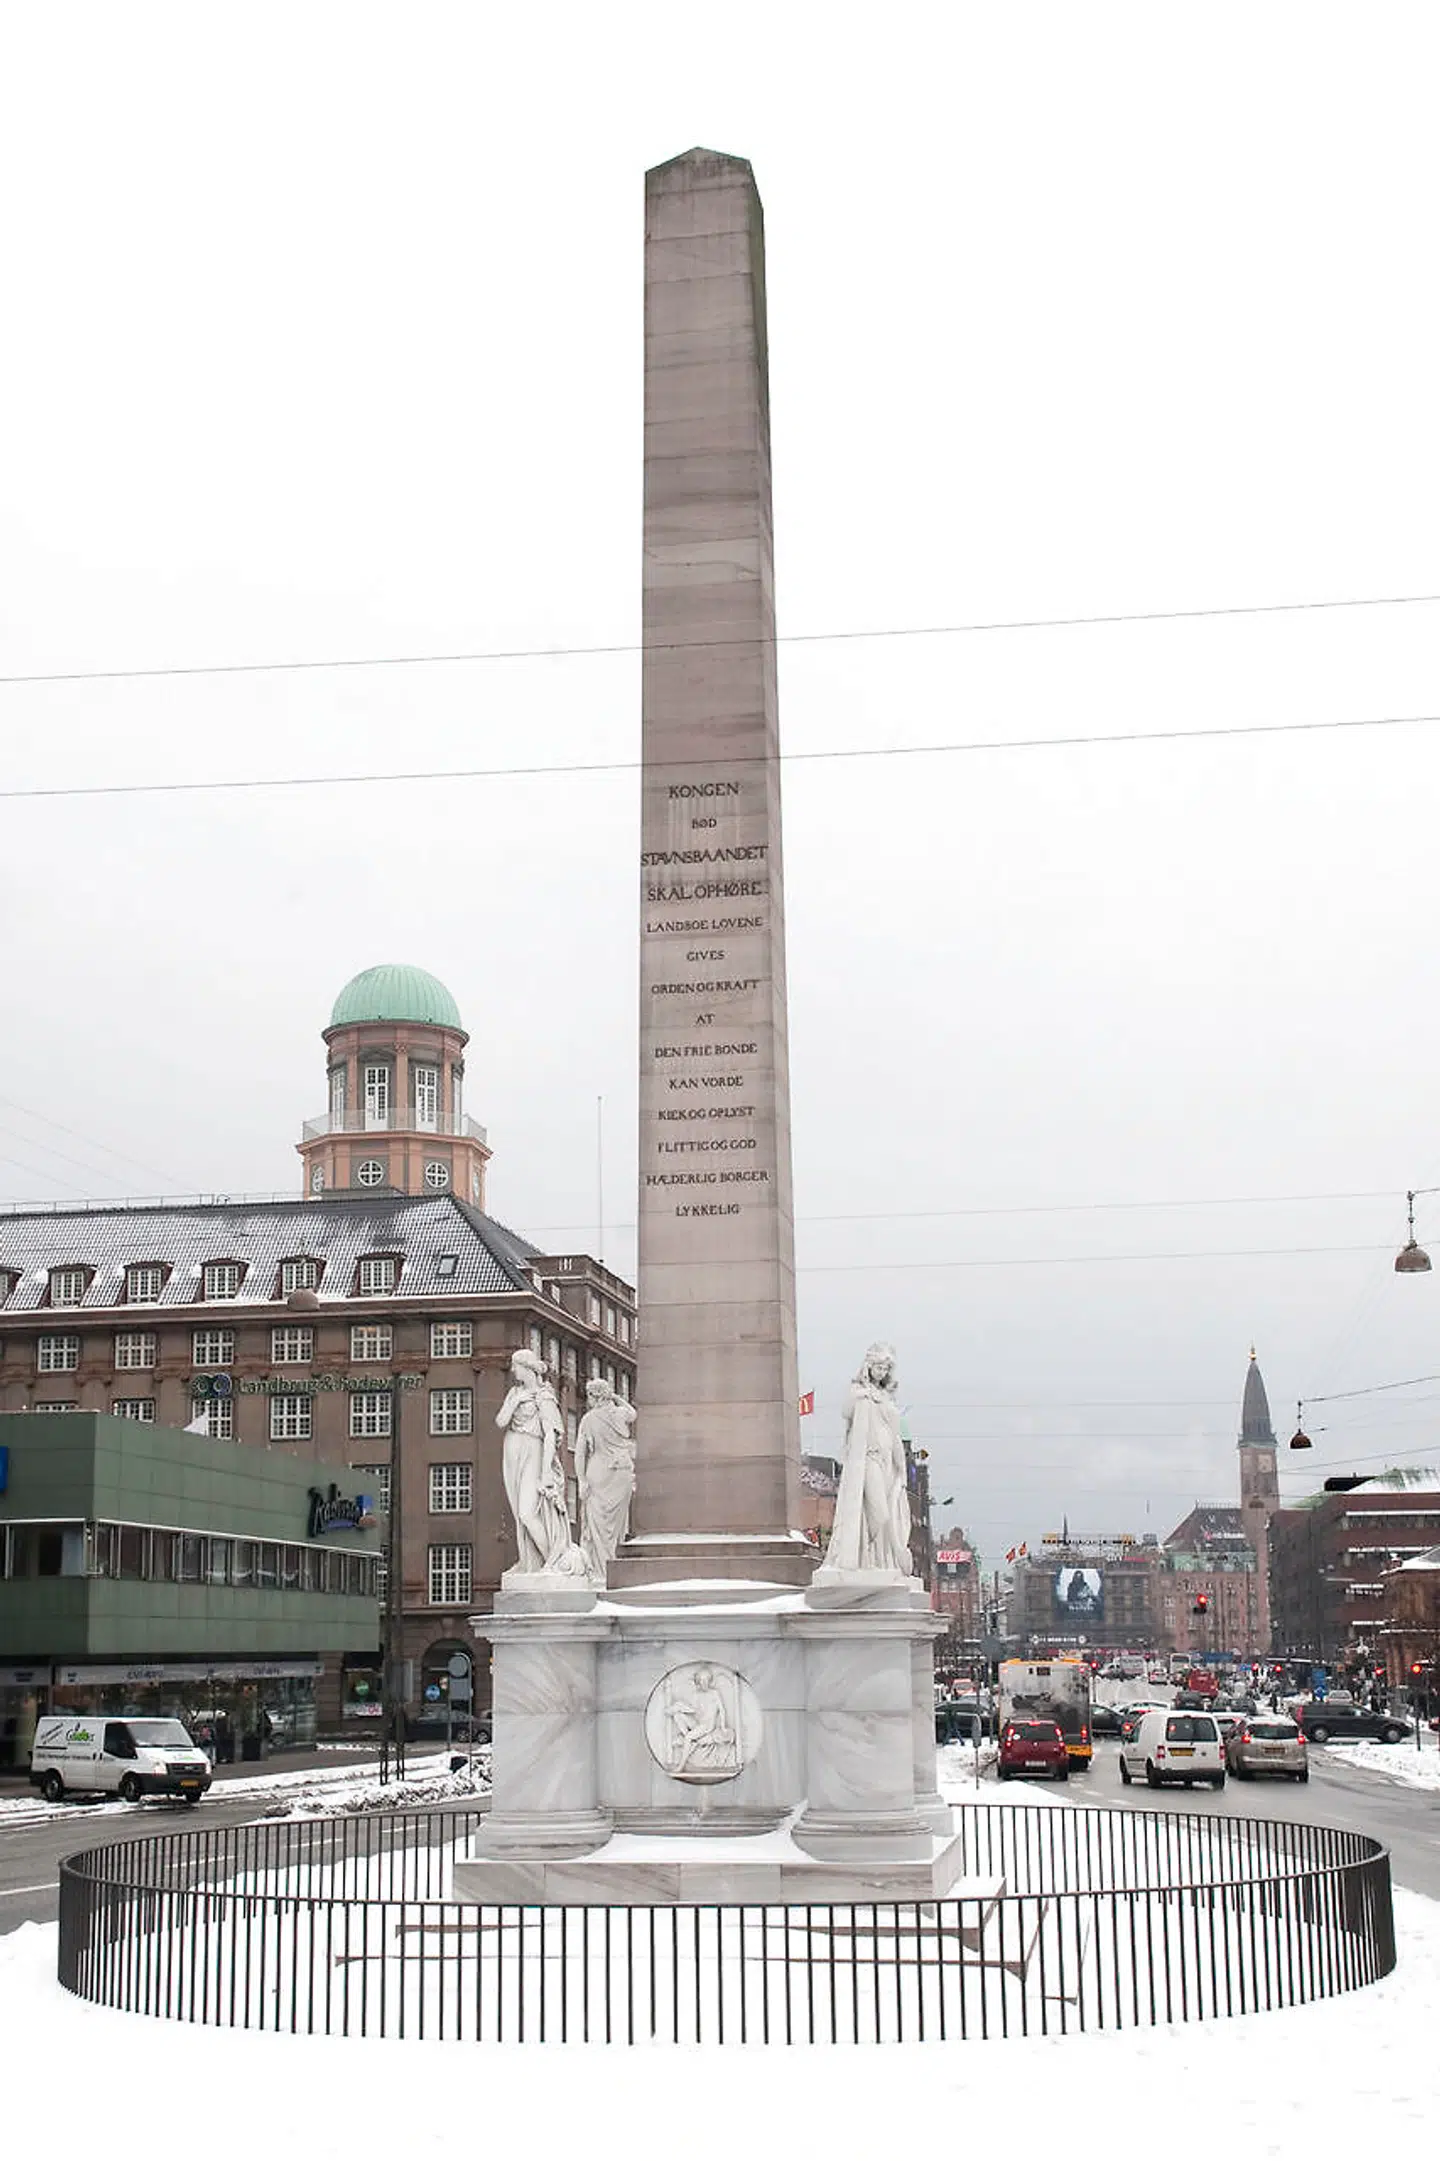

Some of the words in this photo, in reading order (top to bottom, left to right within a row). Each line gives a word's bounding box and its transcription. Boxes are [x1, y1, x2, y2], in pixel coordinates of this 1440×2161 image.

[669, 783, 740, 798] KONGEN
[641, 846, 769, 866] STAVNSBAANDET
[648, 886, 692, 901] SKAL
[647, 920, 708, 933] LANDBOE
[712, 917, 763, 930] LOVENE
[686, 950, 725, 961] GIVES
[651, 983, 694, 995] ORDEN
[696, 981, 714, 992] OG
[716, 979, 759, 991] KRAFT
[695, 1014, 715, 1025] AT
[655, 1047, 681, 1058] DEN
[683, 1046, 712, 1057] FRIE
[714, 1043, 758, 1055] BONDE
[669, 1078, 699, 1090] KAN
[702, 1076, 743, 1088] VORDE
[688, 1109, 706, 1119] OG
[708, 1106, 755, 1118] OPLYST
[658, 1141, 710, 1153] FLITTIG
[710, 1141, 729, 1151] OG
[730, 1139, 756, 1150] GOD
[647, 1173, 717, 1186] HÆDERLIG
[720, 1171, 769, 1184] BORGER
[676, 1204, 740, 1217] LYKKELIG
